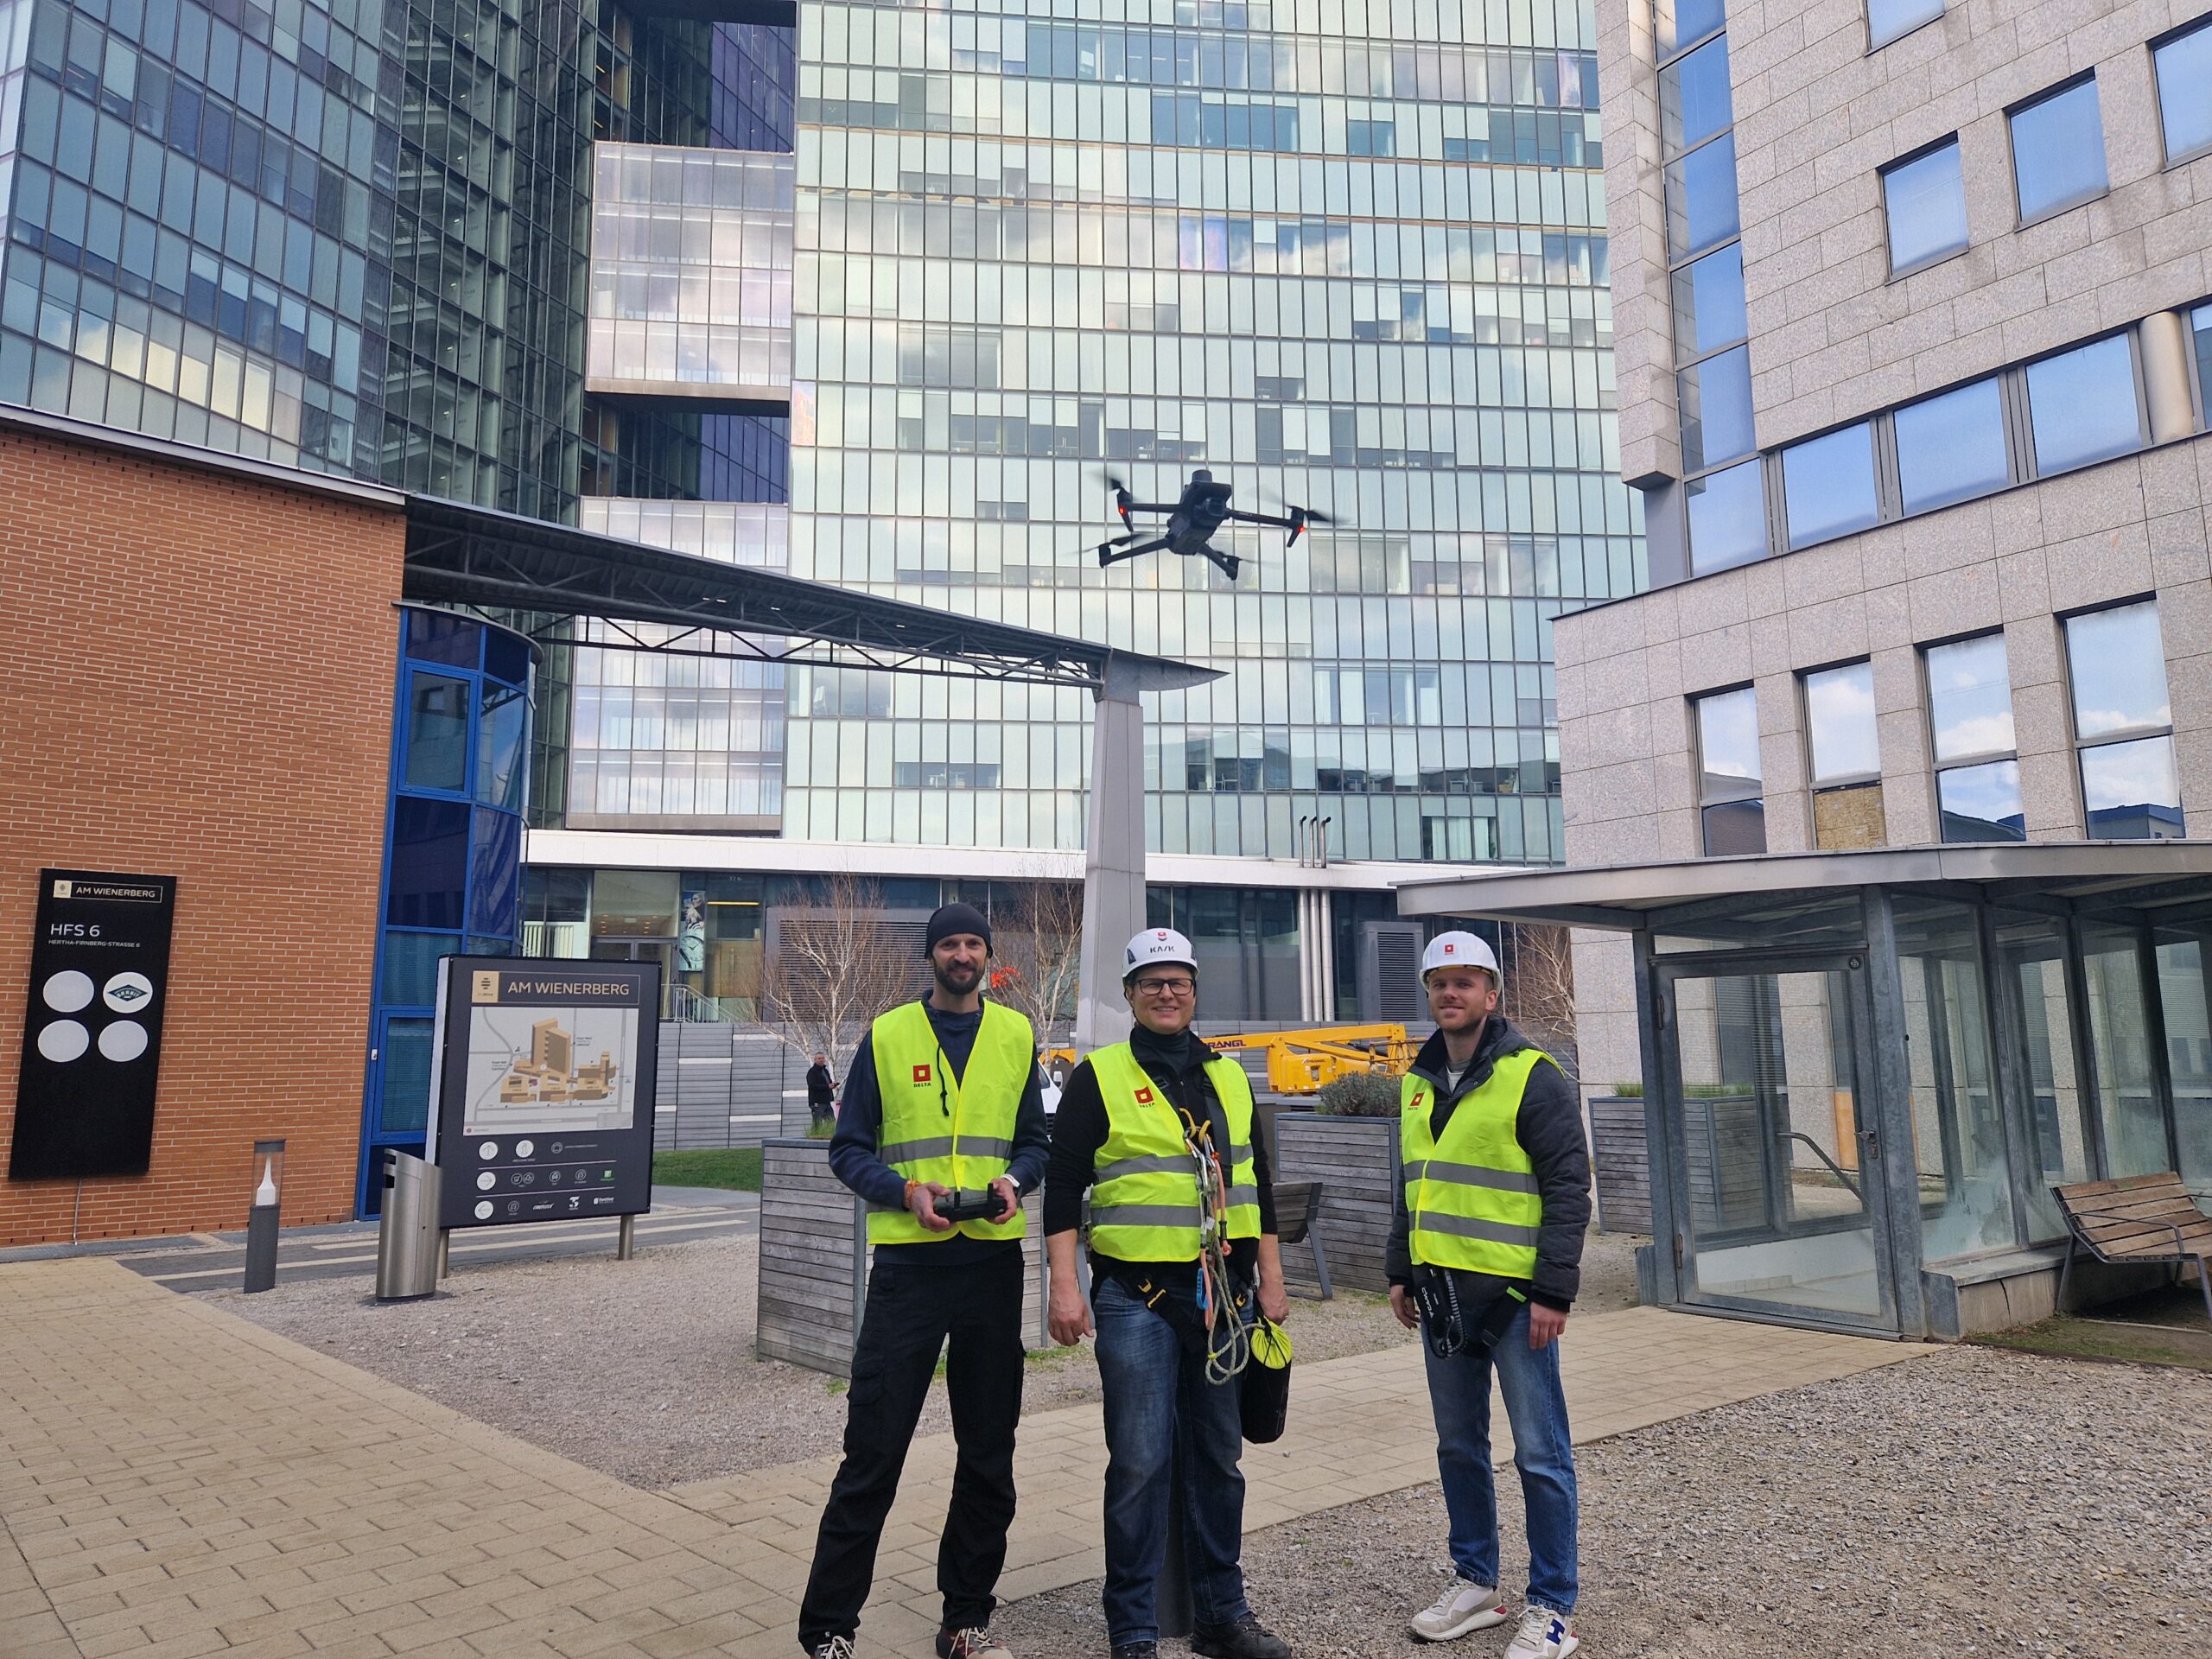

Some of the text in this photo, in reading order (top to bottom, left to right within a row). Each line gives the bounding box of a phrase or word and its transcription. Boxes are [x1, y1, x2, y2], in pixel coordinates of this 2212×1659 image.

[93, 887, 156, 898] WIENERBERG
[50, 924, 100, 938] HFS 6
[508, 982, 531, 994] AM
[535, 982, 629, 995] WIENERBERG
